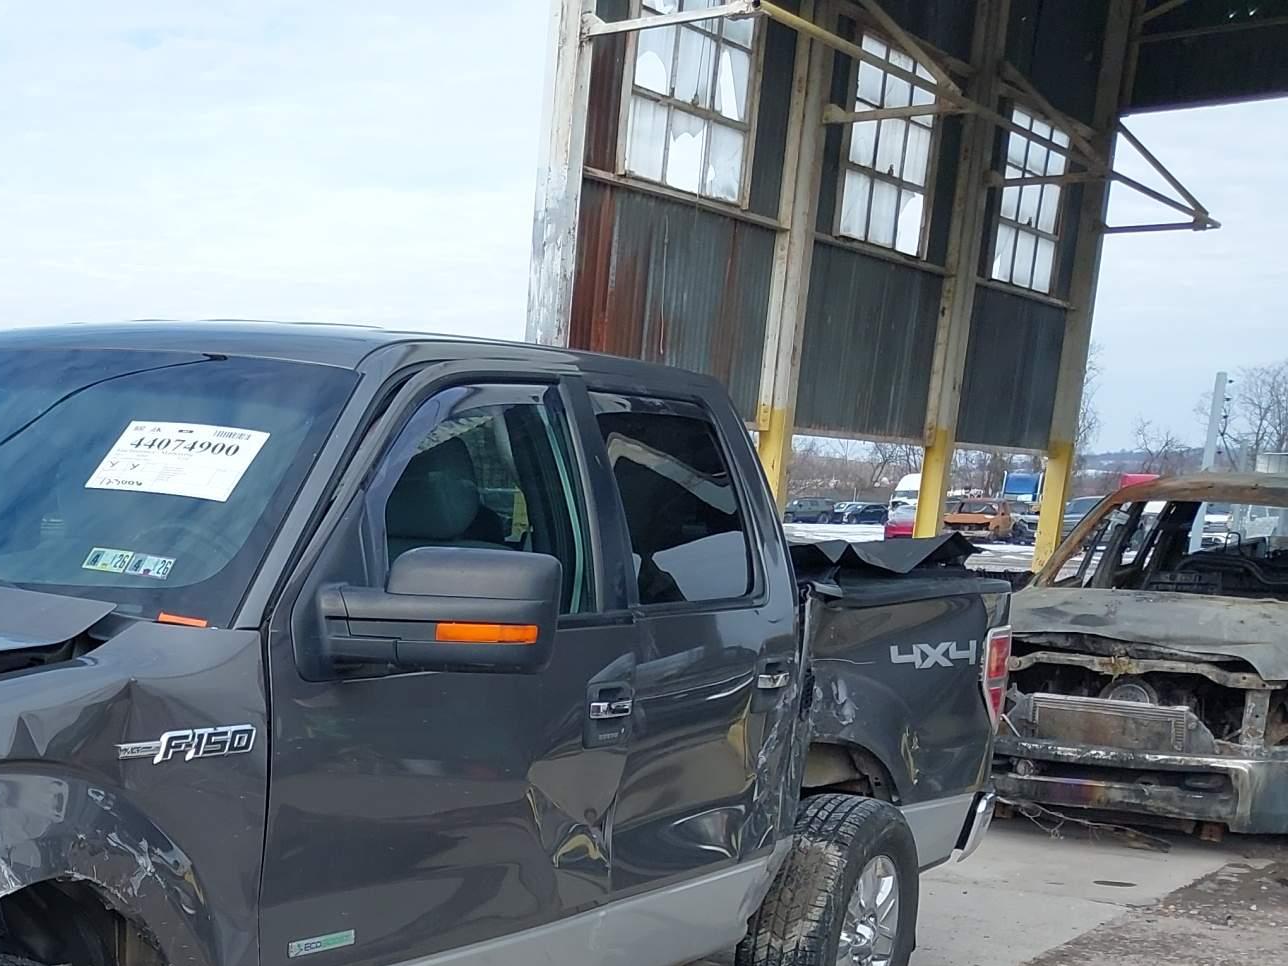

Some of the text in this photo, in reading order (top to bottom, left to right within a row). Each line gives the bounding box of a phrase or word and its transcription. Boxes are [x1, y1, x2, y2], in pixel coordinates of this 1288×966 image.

[130, 436, 240, 457] 44074900
[113, 553, 130, 569] 26
[156, 559, 172, 576] 26
